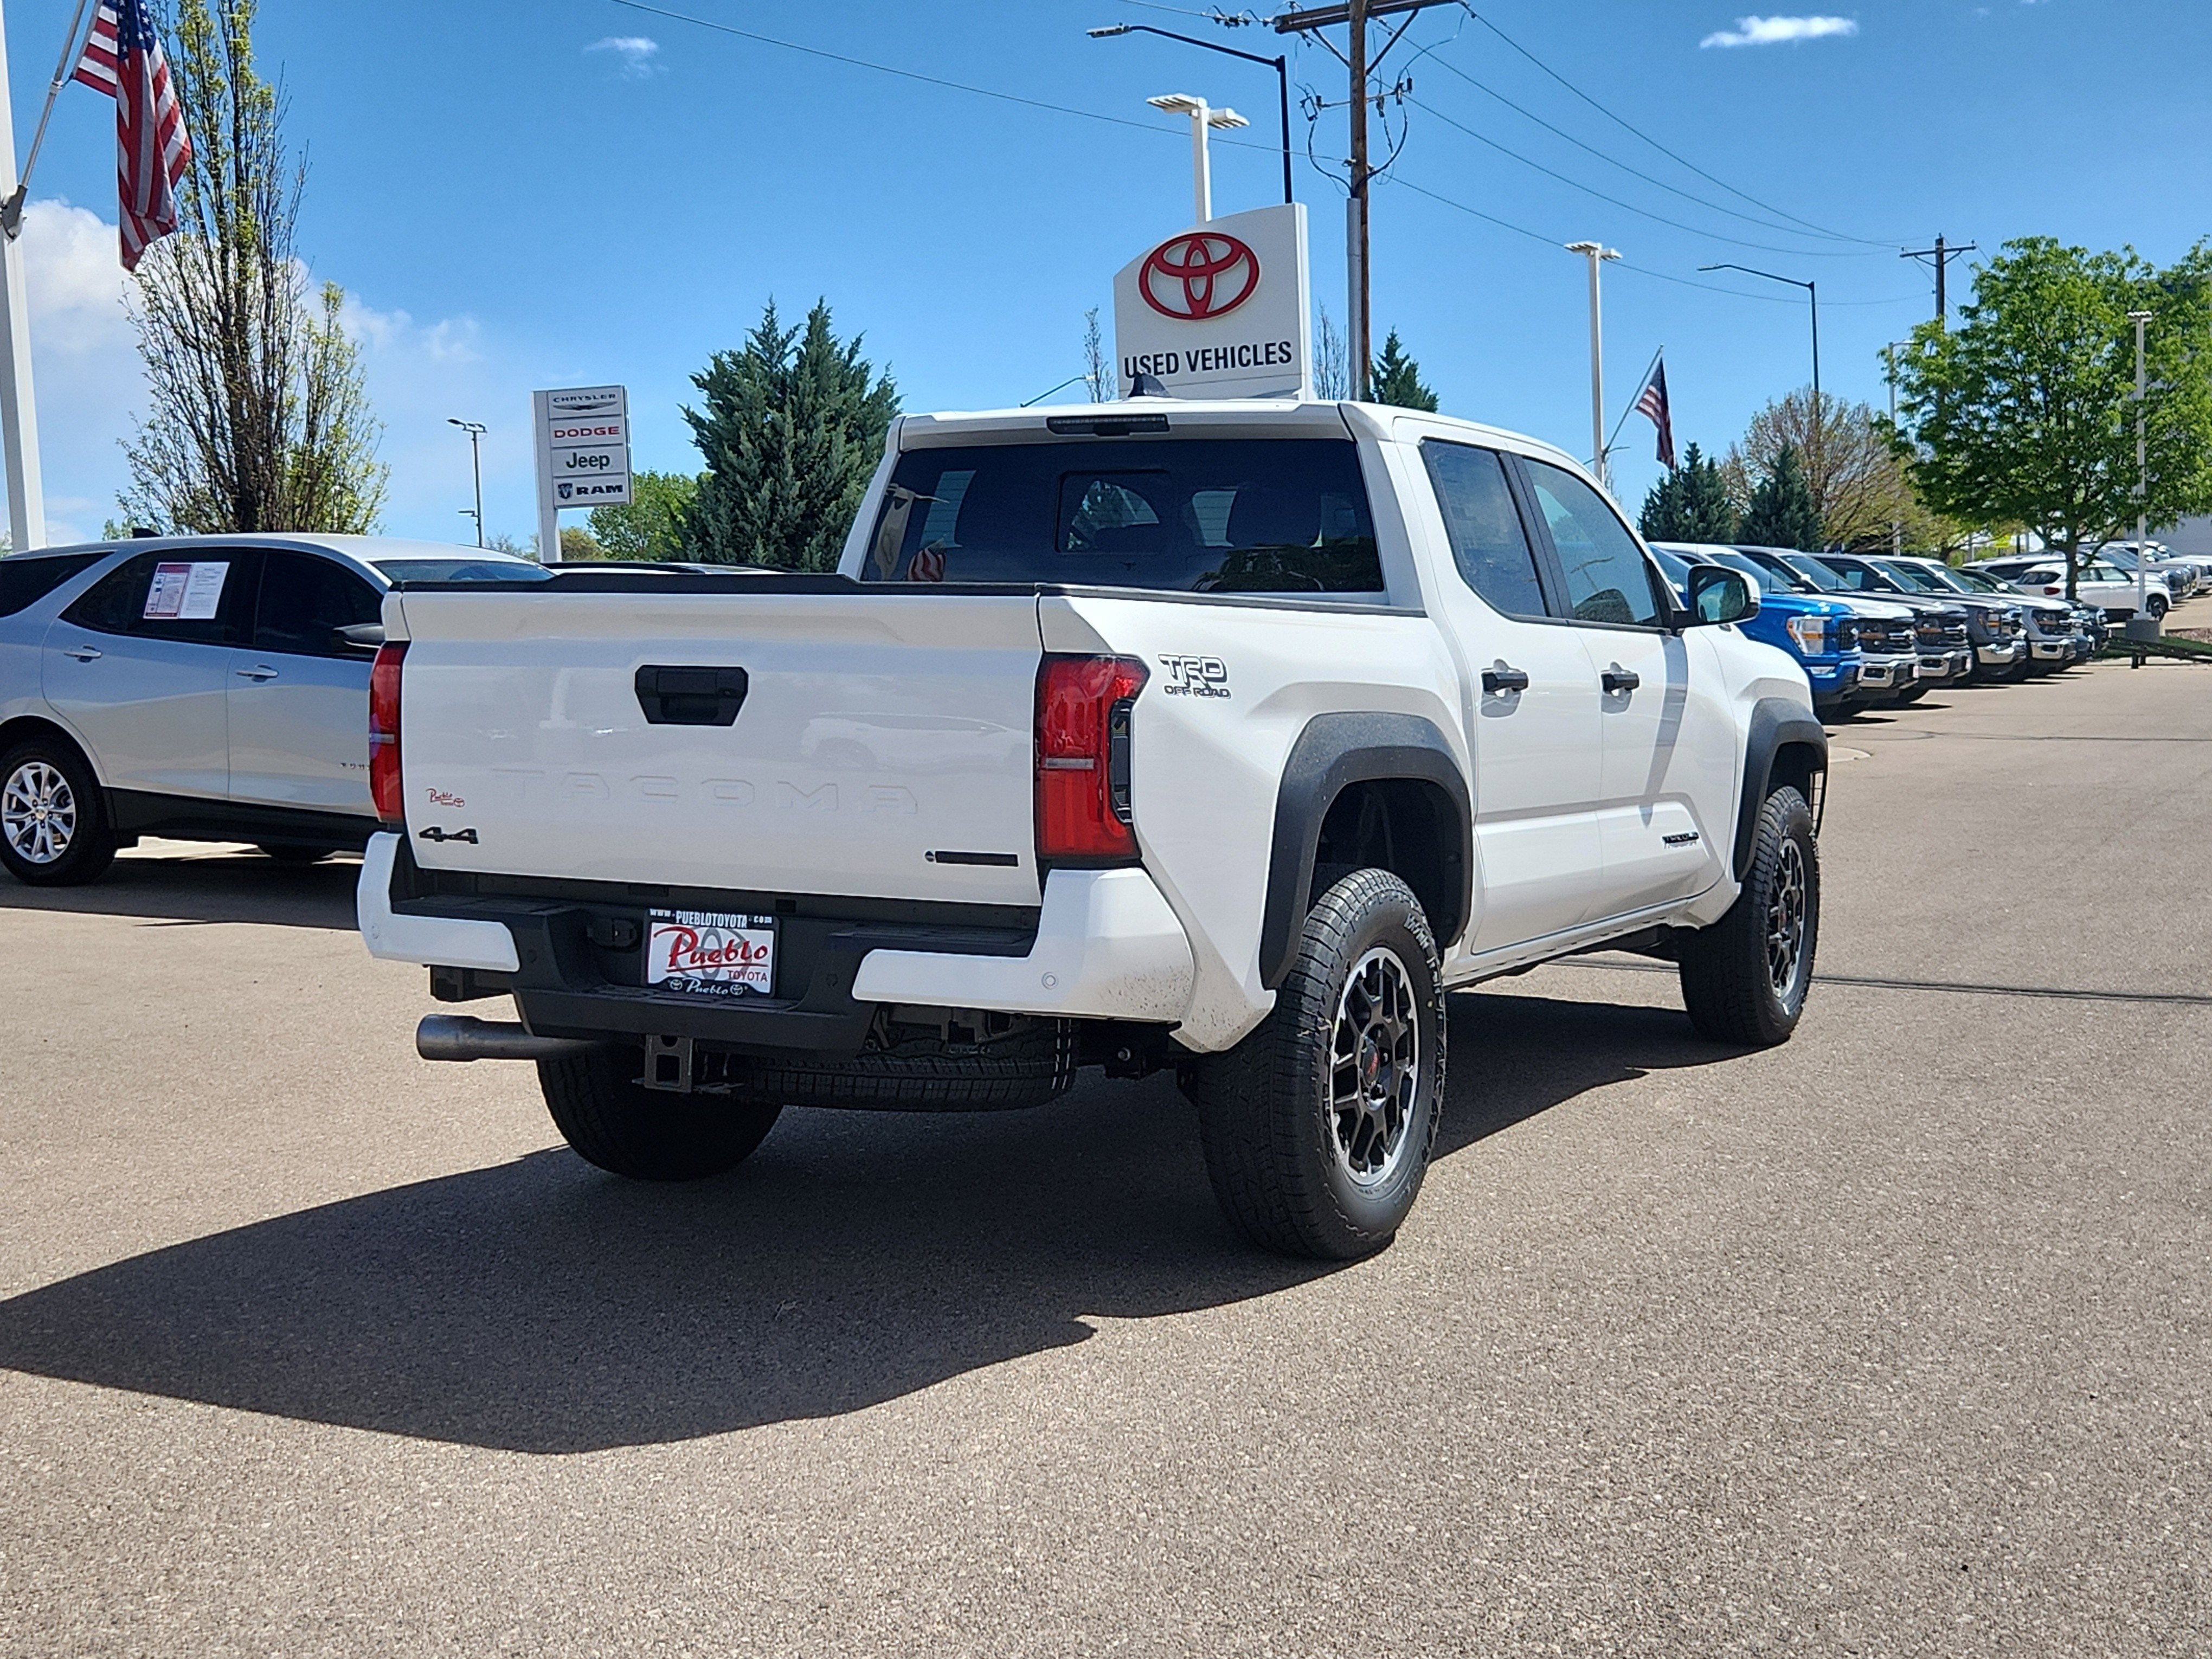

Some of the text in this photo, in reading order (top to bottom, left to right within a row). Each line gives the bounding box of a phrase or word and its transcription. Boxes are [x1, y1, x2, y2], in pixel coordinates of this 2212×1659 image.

[1124, 341, 1292, 379] USED VEHICLES
[553, 394, 616, 403] CHRYSLER
[554, 426, 620, 439] DODGE
[566, 452, 610, 470] Jeep
[576, 485, 623, 496] RAM
[1158, 654, 1227, 689] TRD
[1165, 685, 1231, 699] OFF ROAD
[491, 768, 918, 814] TACOMA
[653, 926, 768, 968] Pueblo
[727, 970, 768, 982] TOYOTA
[682, 978, 729, 995] Pueblo
